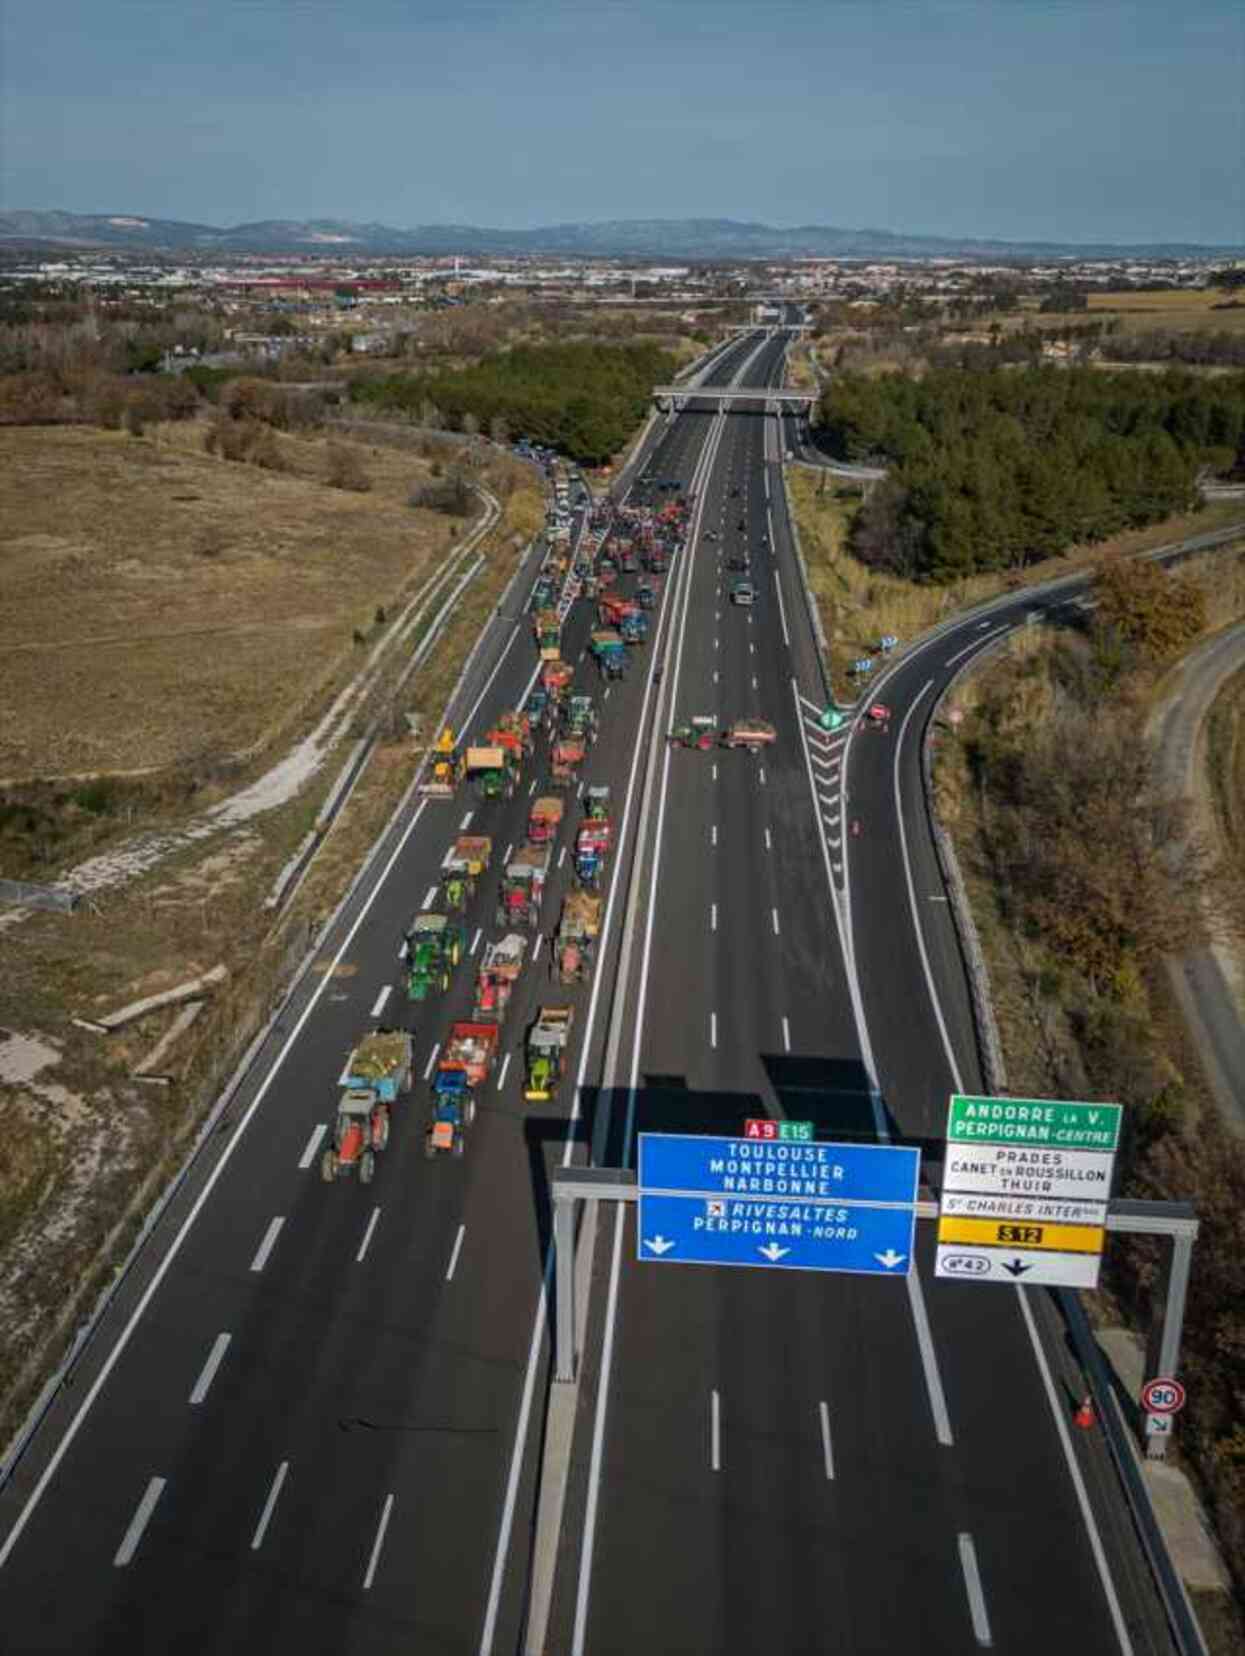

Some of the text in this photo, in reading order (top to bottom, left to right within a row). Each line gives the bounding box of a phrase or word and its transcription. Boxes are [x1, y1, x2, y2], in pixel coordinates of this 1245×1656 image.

[965, 1103, 1055, 1122] ANDORRE
[1088, 1111, 1105, 1126] V.
[730, 1144, 828, 1162] TOULOUSE
[996, 1151, 1062, 1165] PRADES
[710, 1160, 844, 1181] MONTPELLIER
[951, 1162, 996, 1175] CANET
[1016, 1166, 1106, 1182] ROUSSILLON
[723, 1175, 830, 1196] NARBONNE
[1001, 1179, 1051, 1191] THUIR
[732, 1203, 849, 1223] RIVESALTES
[966, 1200, 1034, 1215] CHARLES
[1152, 1388, 1175, 1404] 90
